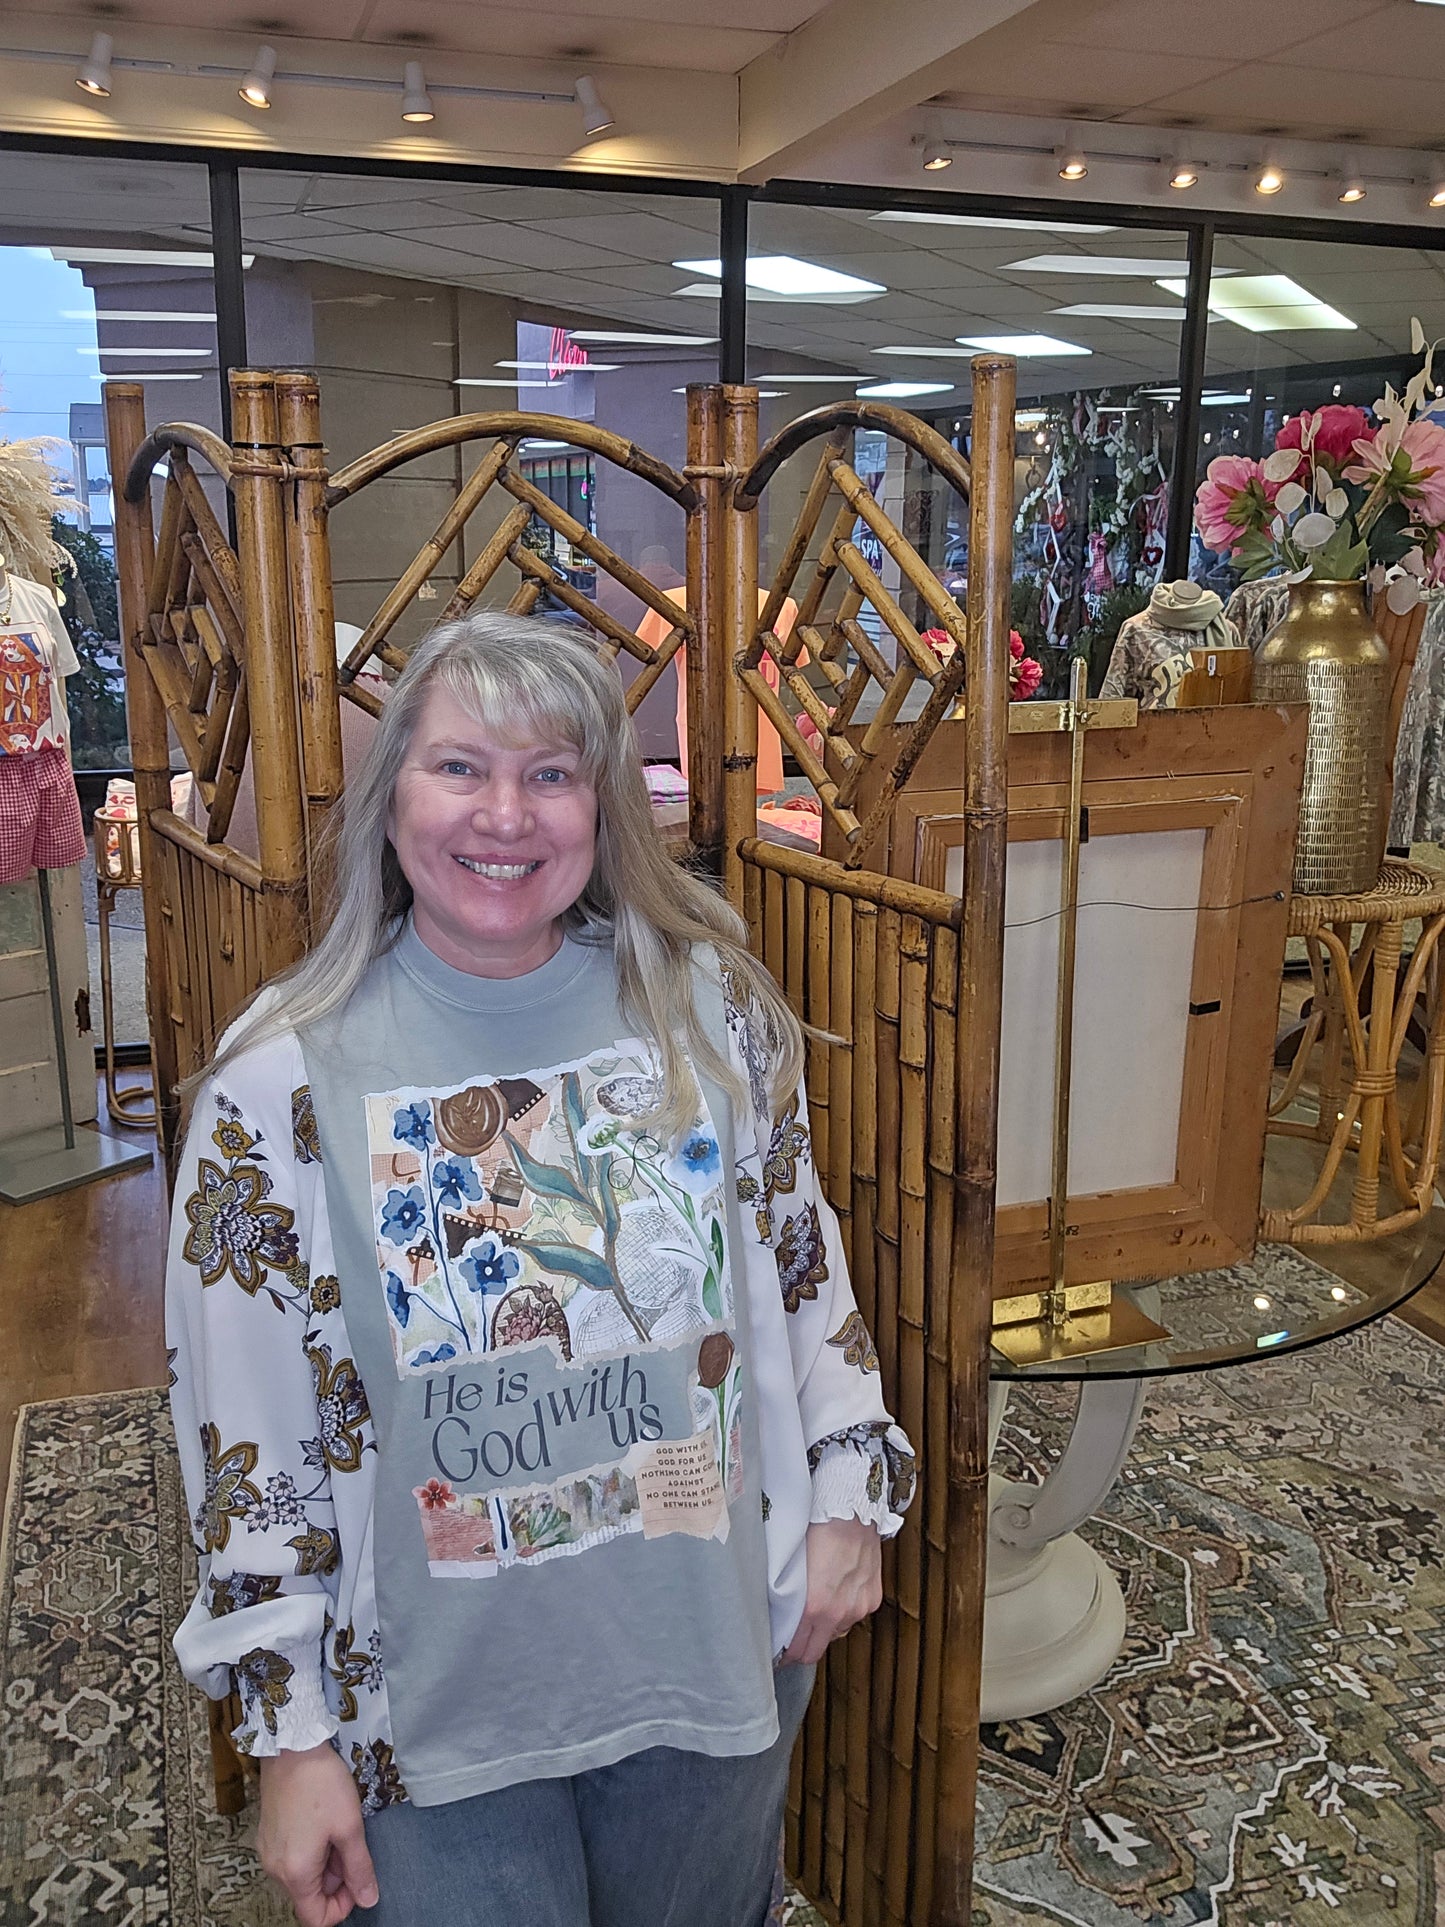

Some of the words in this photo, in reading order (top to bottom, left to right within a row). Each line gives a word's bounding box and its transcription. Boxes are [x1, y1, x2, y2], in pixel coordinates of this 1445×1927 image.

[423, 1374, 482, 1420] He
[495, 1367, 529, 1407] is
[431, 1398, 552, 1483] God
[546, 1355, 648, 1426] with
[606, 1403, 664, 1448] us
[676, 1444, 698, 1453] WITH
[641, 1469, 680, 1479] NOTHING
[668, 1478, 704, 1486] AGAINST
